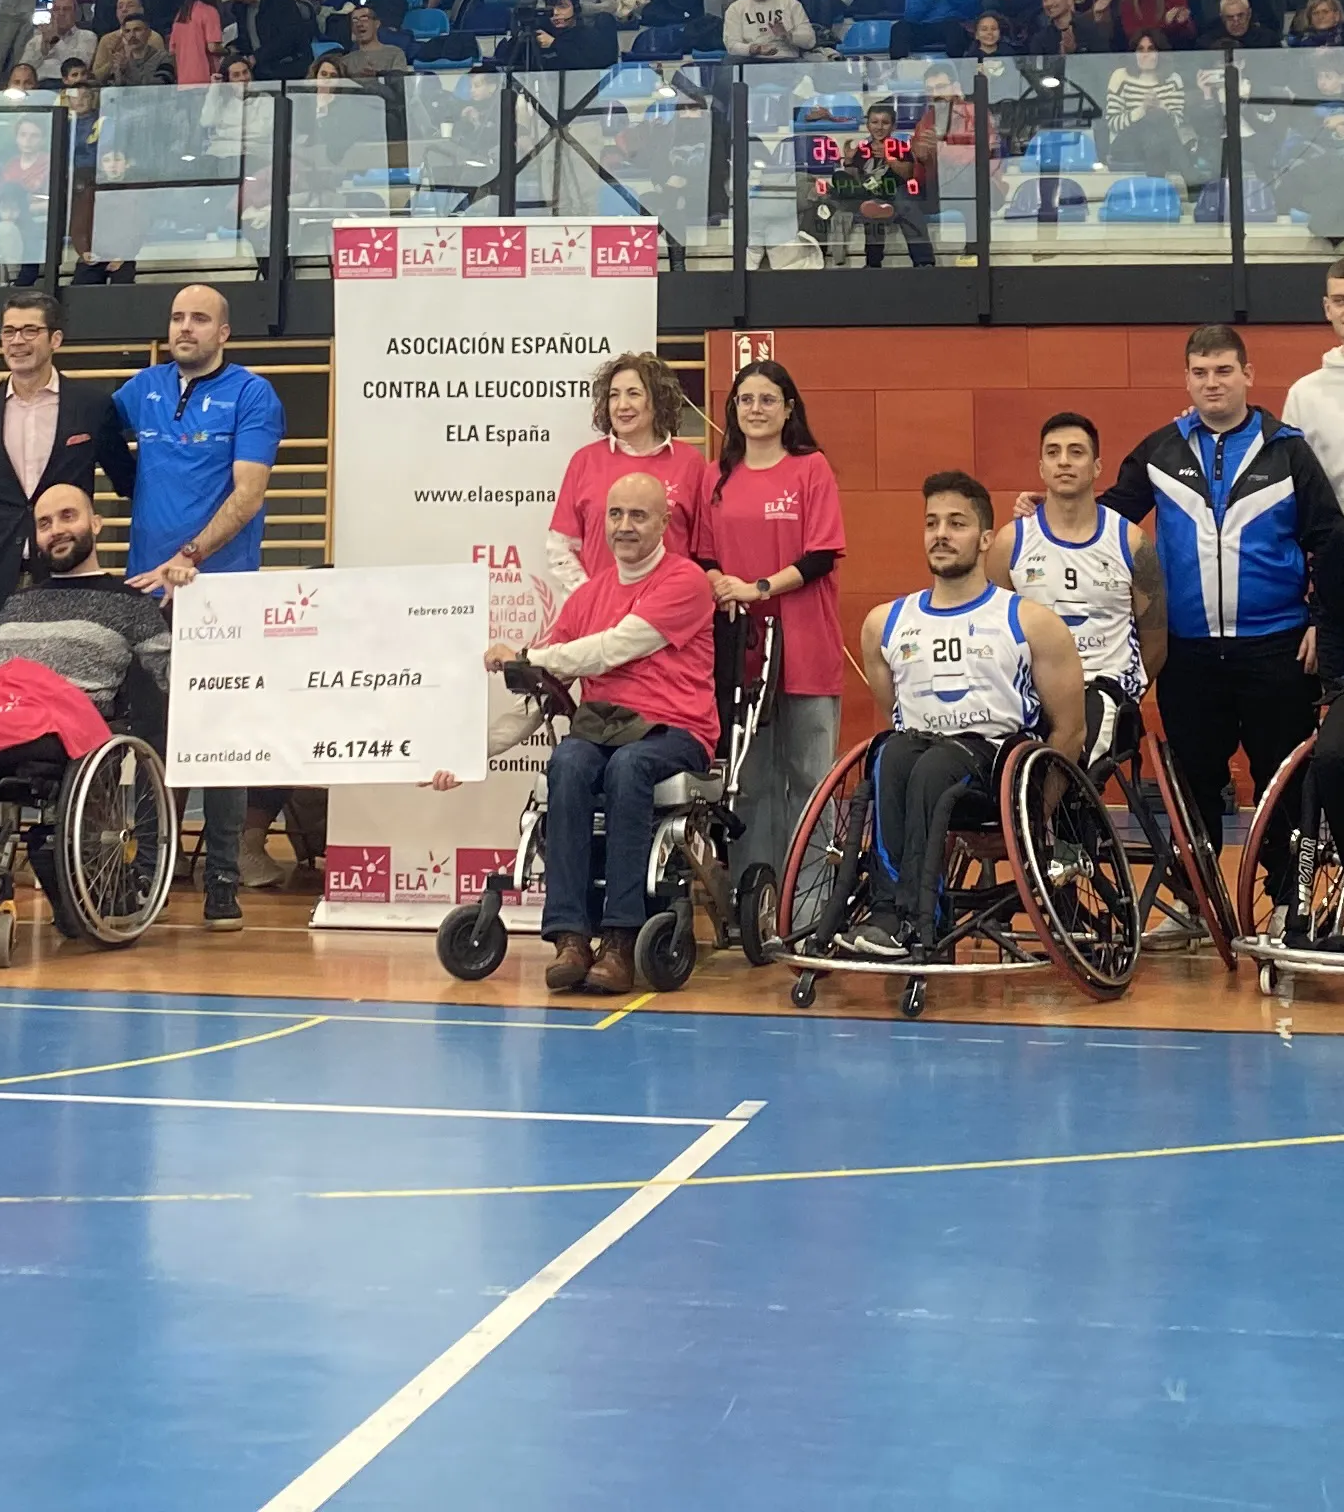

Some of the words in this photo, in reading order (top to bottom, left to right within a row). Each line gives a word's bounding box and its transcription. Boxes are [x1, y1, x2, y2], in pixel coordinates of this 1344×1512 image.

[745, 9, 783, 24] LOIS
[338, 249, 370, 265] ELA
[402, 249, 434, 265] ELA
[466, 248, 499, 265] ELA
[531, 247, 563, 264] ELA
[596, 247, 630, 264] ELA
[386, 332, 504, 355] ASOCIACIÓN
[511, 332, 611, 354] ESPAÑOLA
[363, 381, 440, 398] CONTRA
[447, 381, 469, 398] LA
[475, 380, 591, 398] LEUCODISTR
[446, 425, 479, 442] ELA
[486, 424, 550, 446] España
[414, 486, 556, 506] www.elaespana
[764, 501, 785, 513] ELA
[489, 569, 522, 584] PAÑA
[1064, 567, 1078, 591] 9
[491, 592, 535, 606] arada
[264, 608, 295, 625] ELA
[408, 606, 449, 617] Febrero
[451, 605, 476, 616] 2023
[489, 608, 536, 623] tilidad
[489, 624, 523, 639] blica
[933, 637, 962, 663] 20
[189, 675, 251, 691] PAGUESE
[256, 675, 265, 689] A
[307, 670, 345, 689] ELA
[350, 668, 423, 692] España
[922, 707, 992, 729] Servigest
[177, 750, 192, 763] La
[195, 750, 252, 764] cantidad
[255, 749, 271, 761] de
[312, 740, 394, 759] #6.174#
[400, 739, 412, 757] €
[489, 755, 545, 772] contin
[329, 871, 363, 890] ELA
[395, 873, 428, 891] ELA
